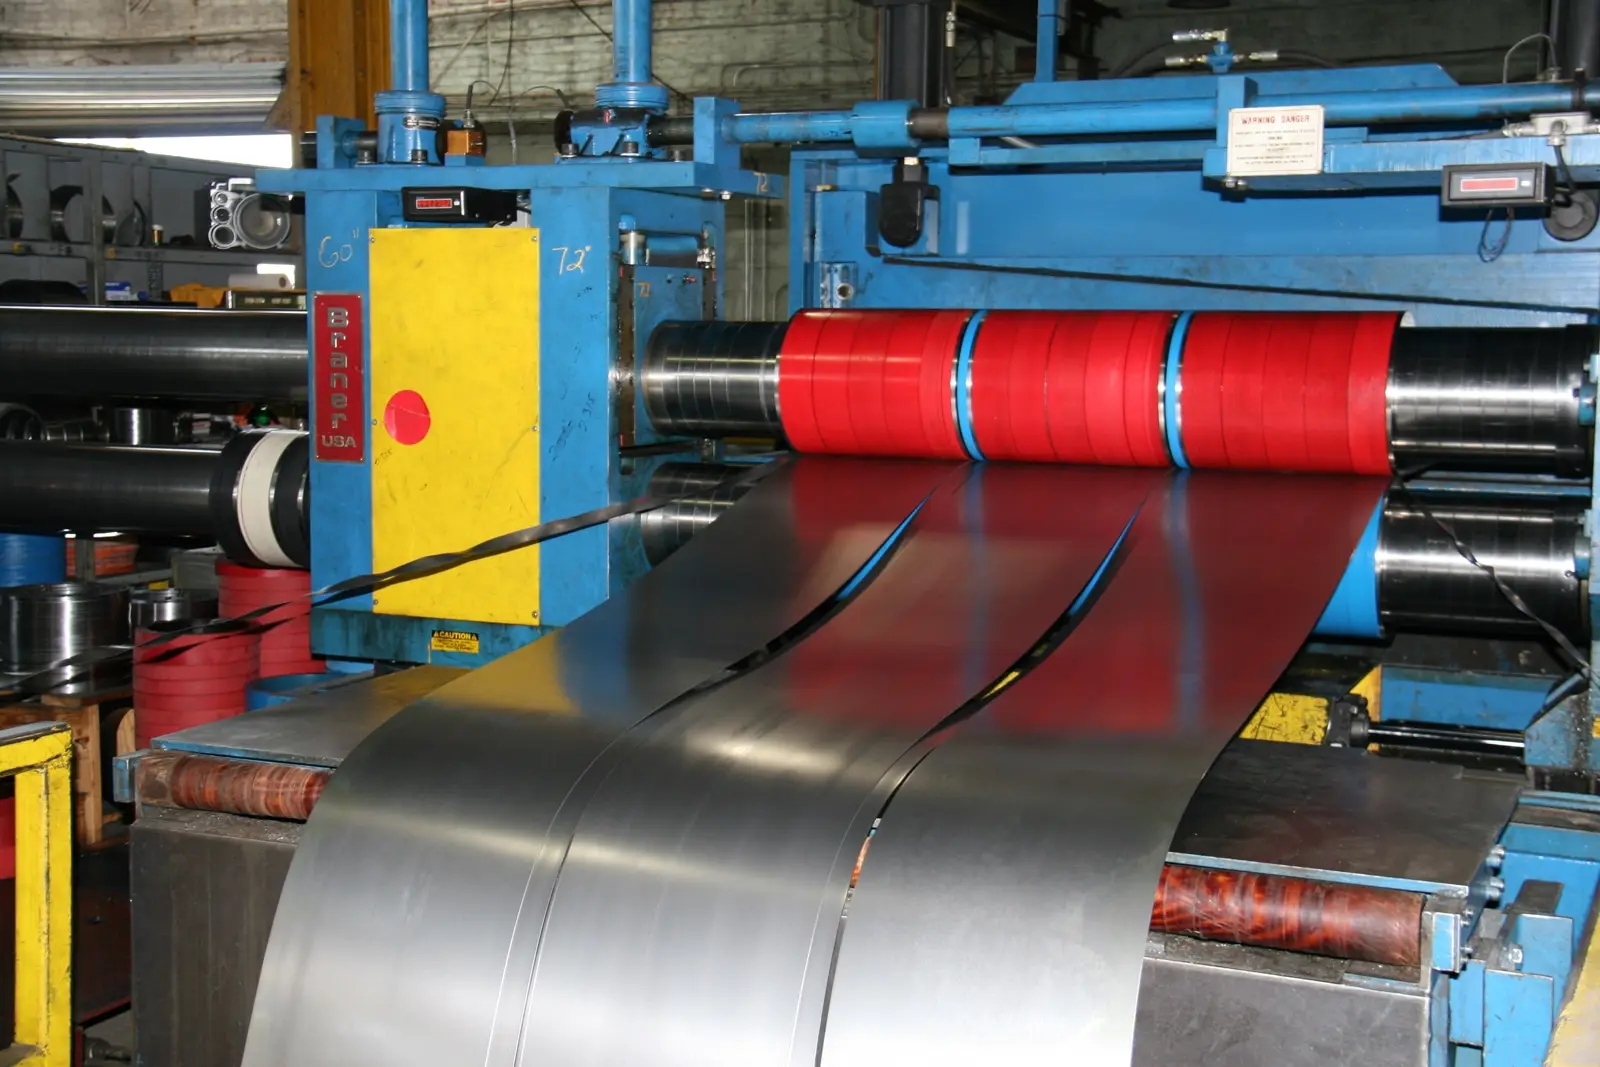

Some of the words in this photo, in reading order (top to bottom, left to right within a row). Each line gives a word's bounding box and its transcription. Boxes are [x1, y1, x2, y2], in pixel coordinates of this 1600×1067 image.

[1241, 116, 1276, 124] WARNING
[1281, 114, 1310, 123] DANGER
[327, 307, 349, 429] Braner
[321, 434, 357, 448] USA
[439, 631, 471, 640] CAUTION
